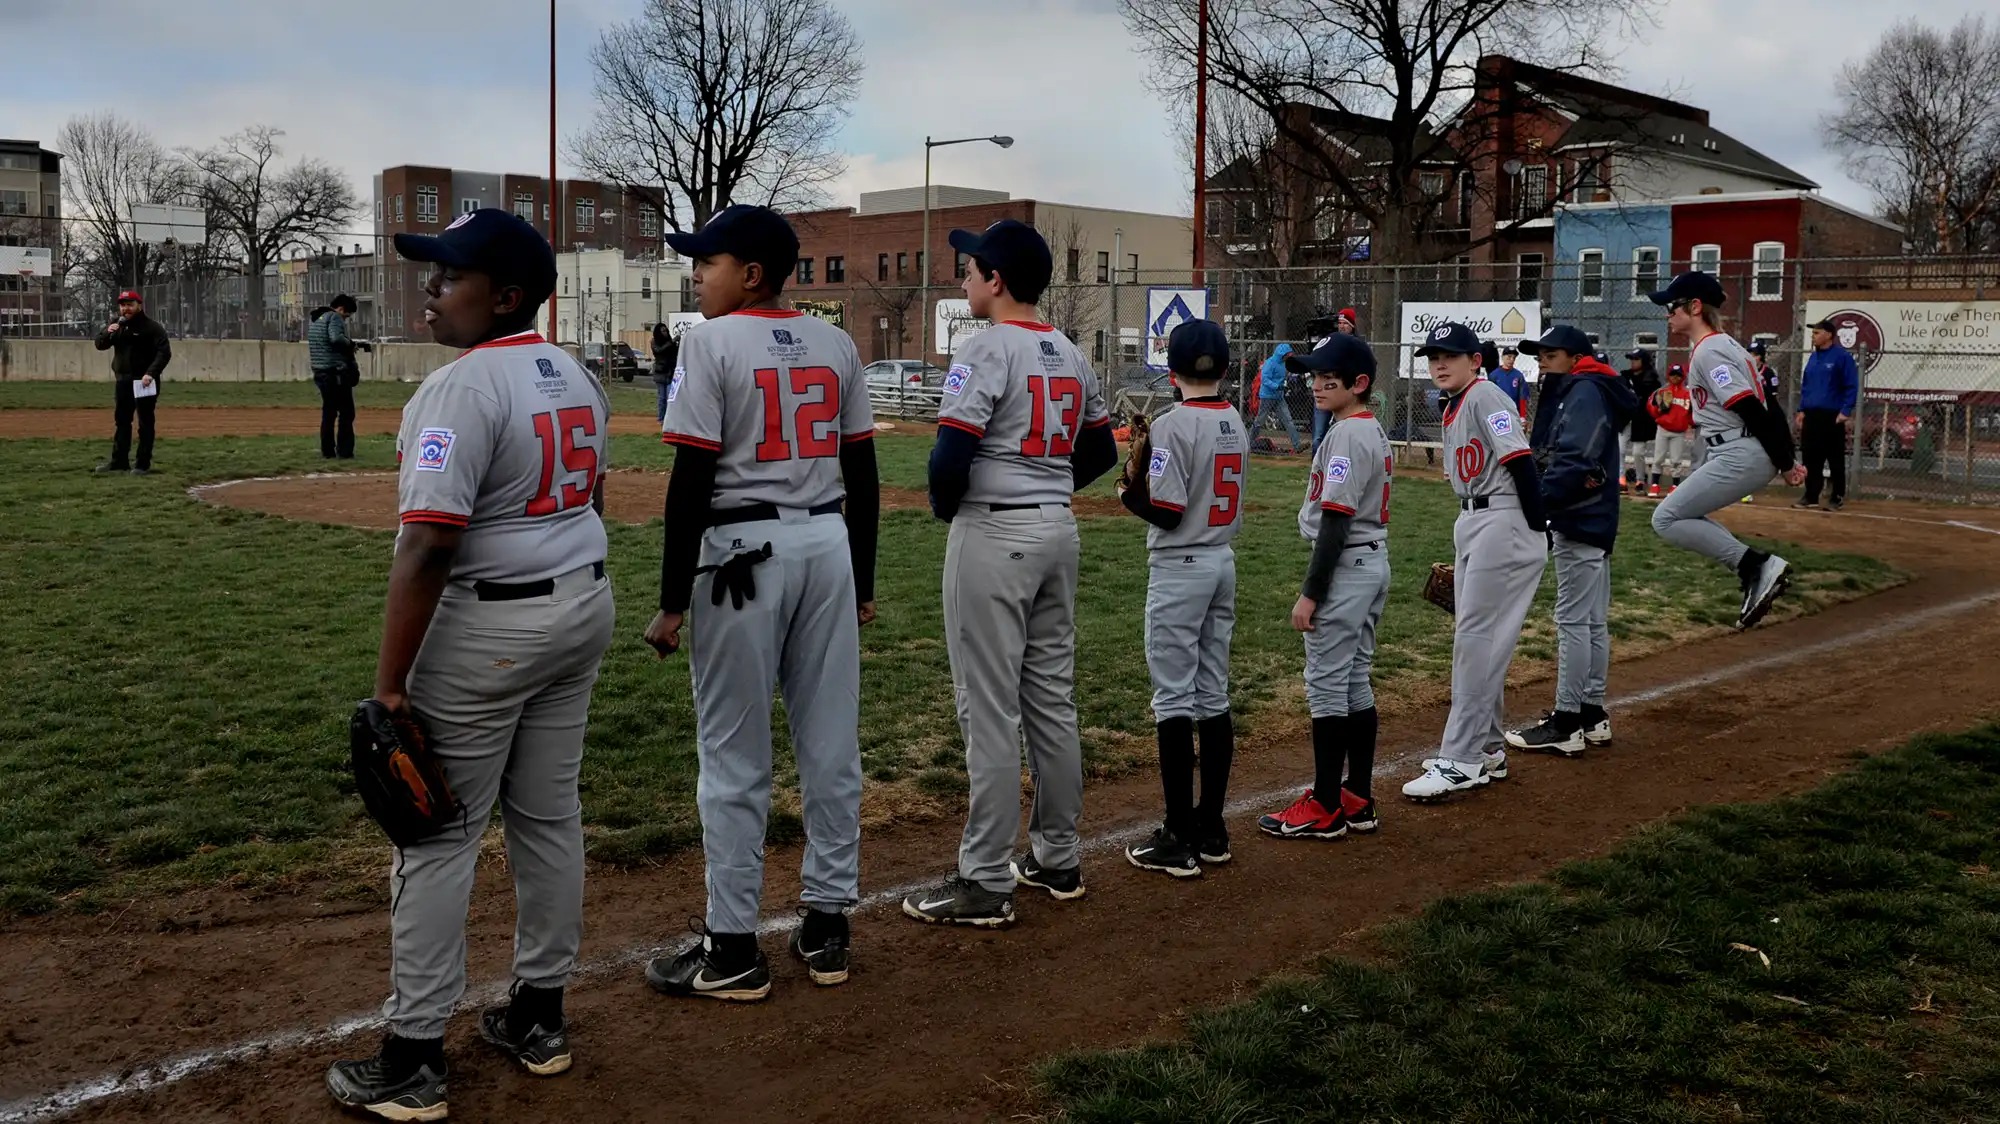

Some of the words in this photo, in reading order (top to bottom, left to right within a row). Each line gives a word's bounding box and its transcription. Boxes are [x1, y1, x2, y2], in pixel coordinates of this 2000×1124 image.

[1900, 309, 1922, 322] We
[1927, 309, 1960, 322] Love
[1900, 325, 1928, 338] Like
[1931, 325, 1958, 338] You
[1963, 325, 1989, 338] Do!
[753, 366, 840, 463] 12
[1020, 374, 1083, 457] 13
[1863, 391, 1959, 402] .savinggracepets.com
[525, 405, 598, 517] 15
[1208, 452, 1242, 527] 5
[1456, 438, 1485, 483] W
